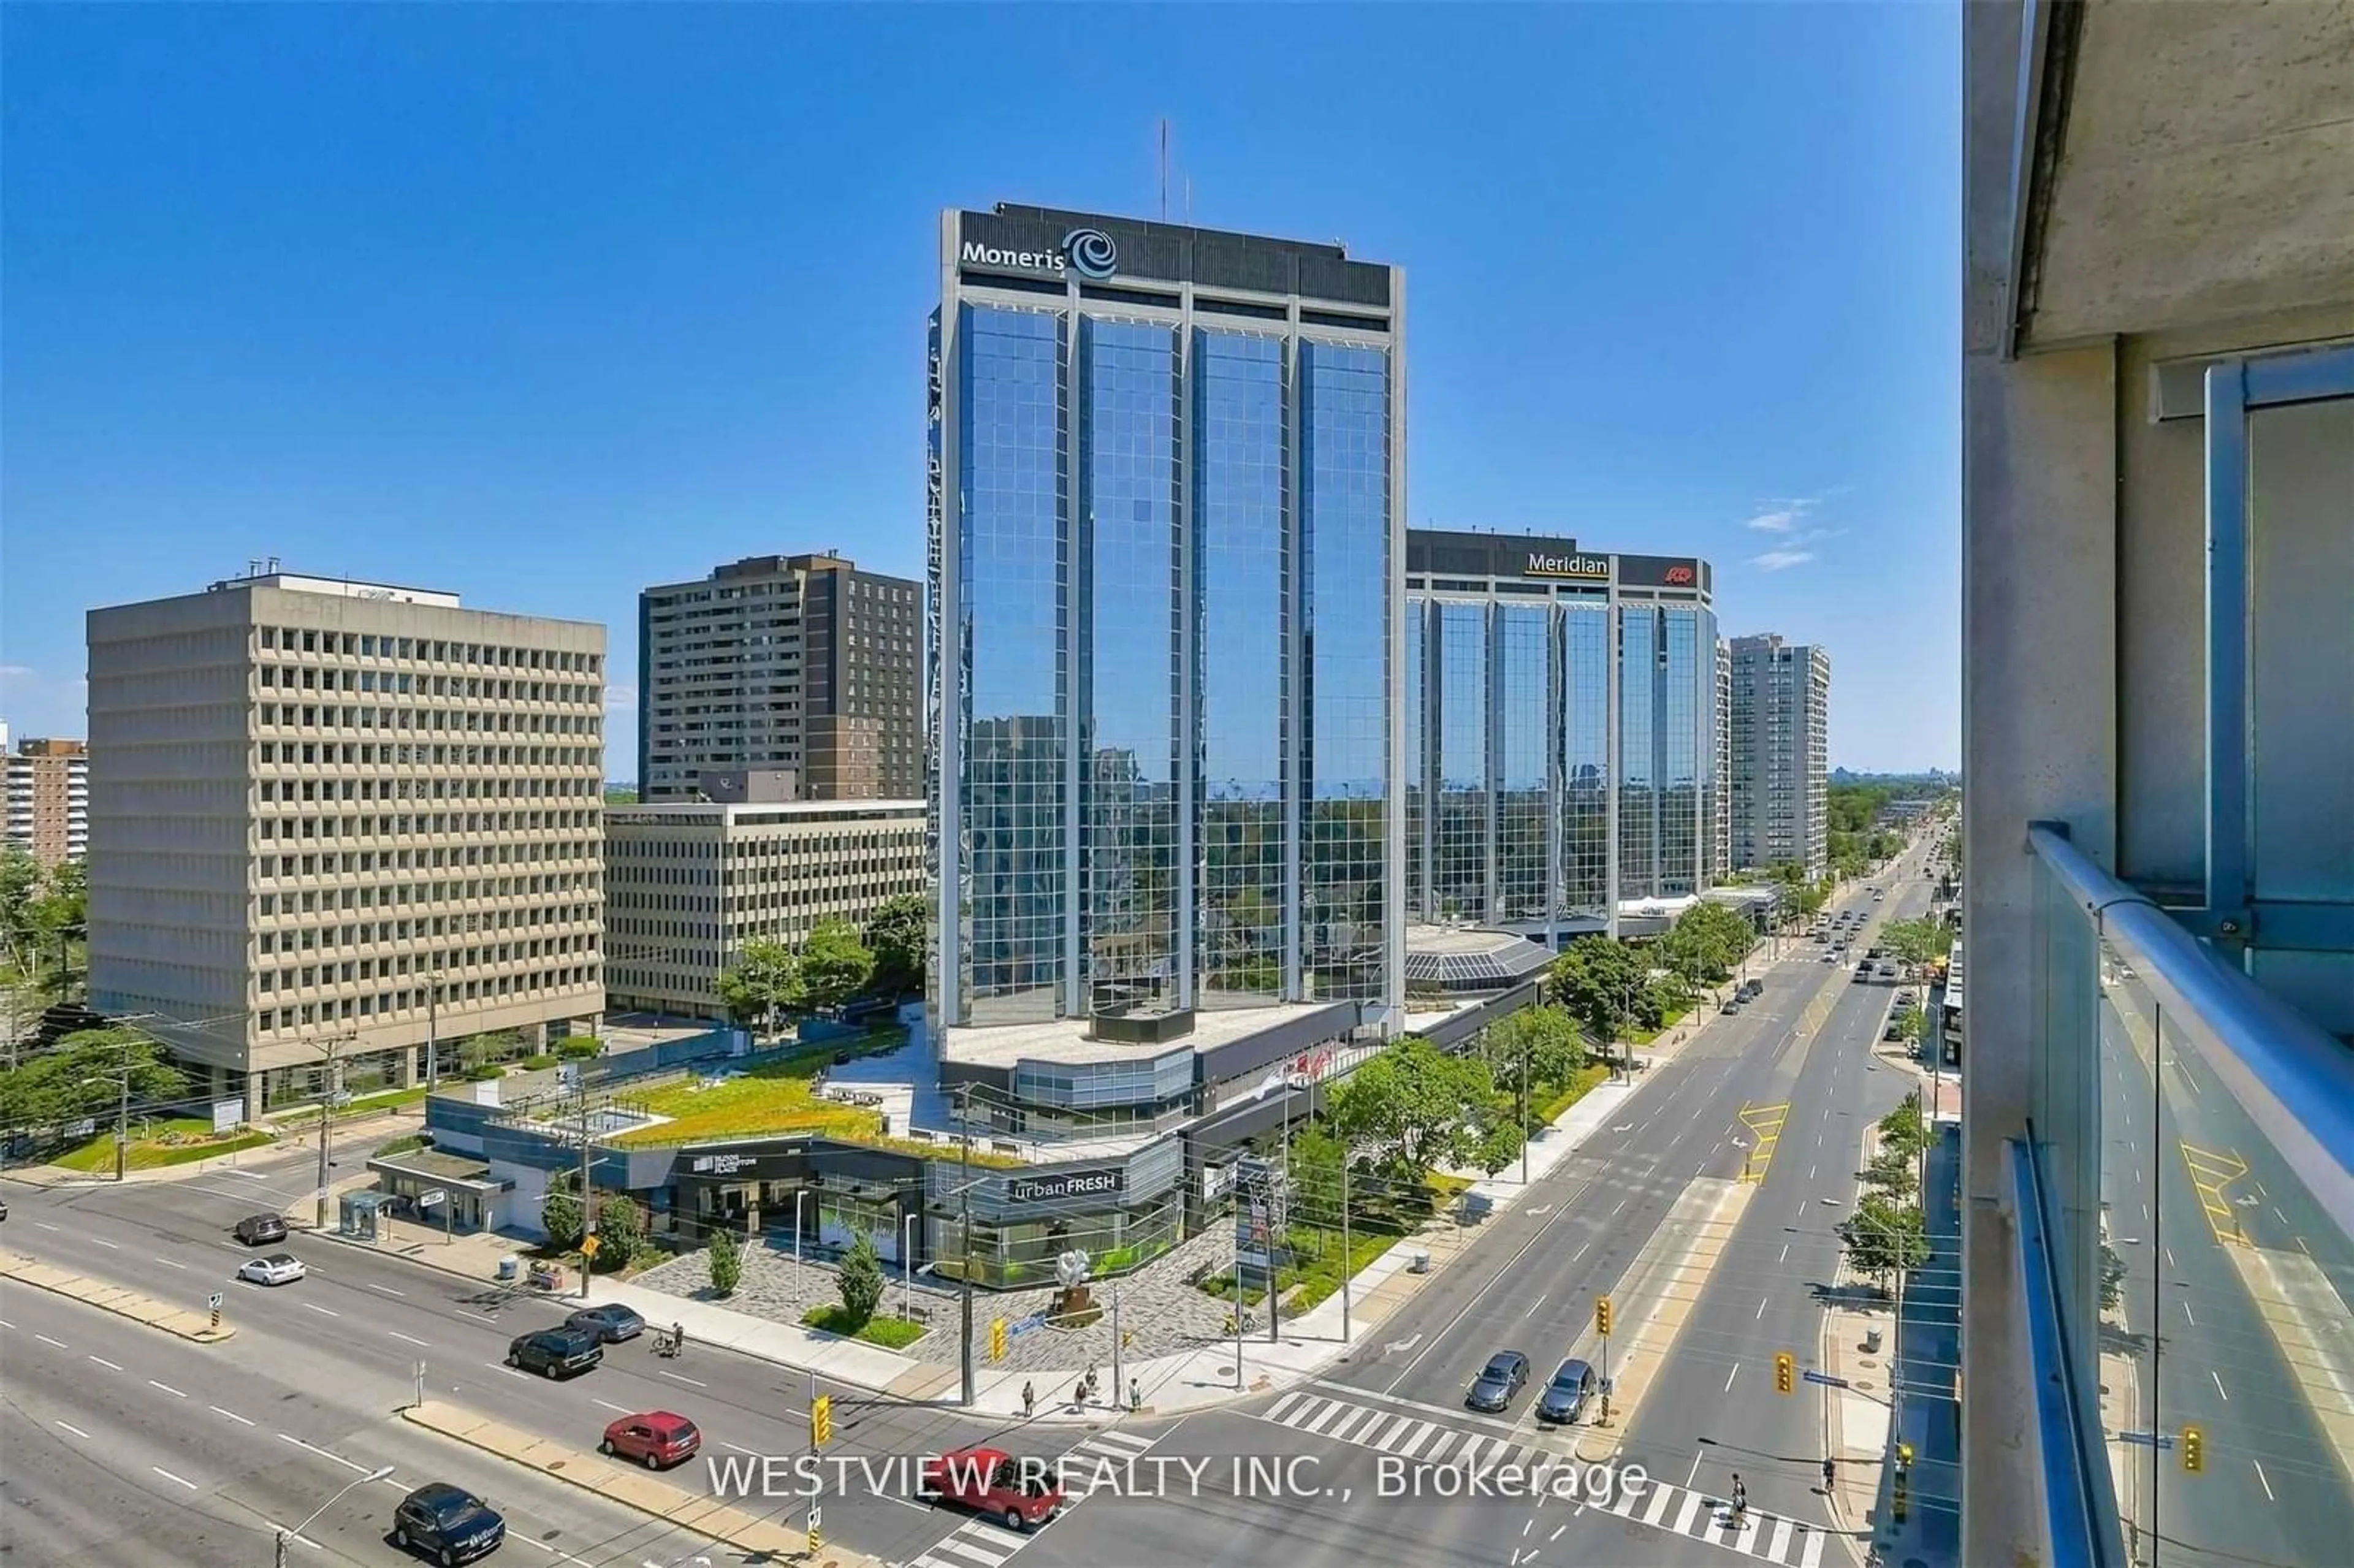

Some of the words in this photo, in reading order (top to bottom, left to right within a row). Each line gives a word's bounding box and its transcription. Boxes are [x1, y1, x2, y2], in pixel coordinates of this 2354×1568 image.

[962, 242, 1065, 271] Moneris
[1529, 553, 1607, 574] Meridian
[1015, 1175, 1114, 1199] urbanFRESH
